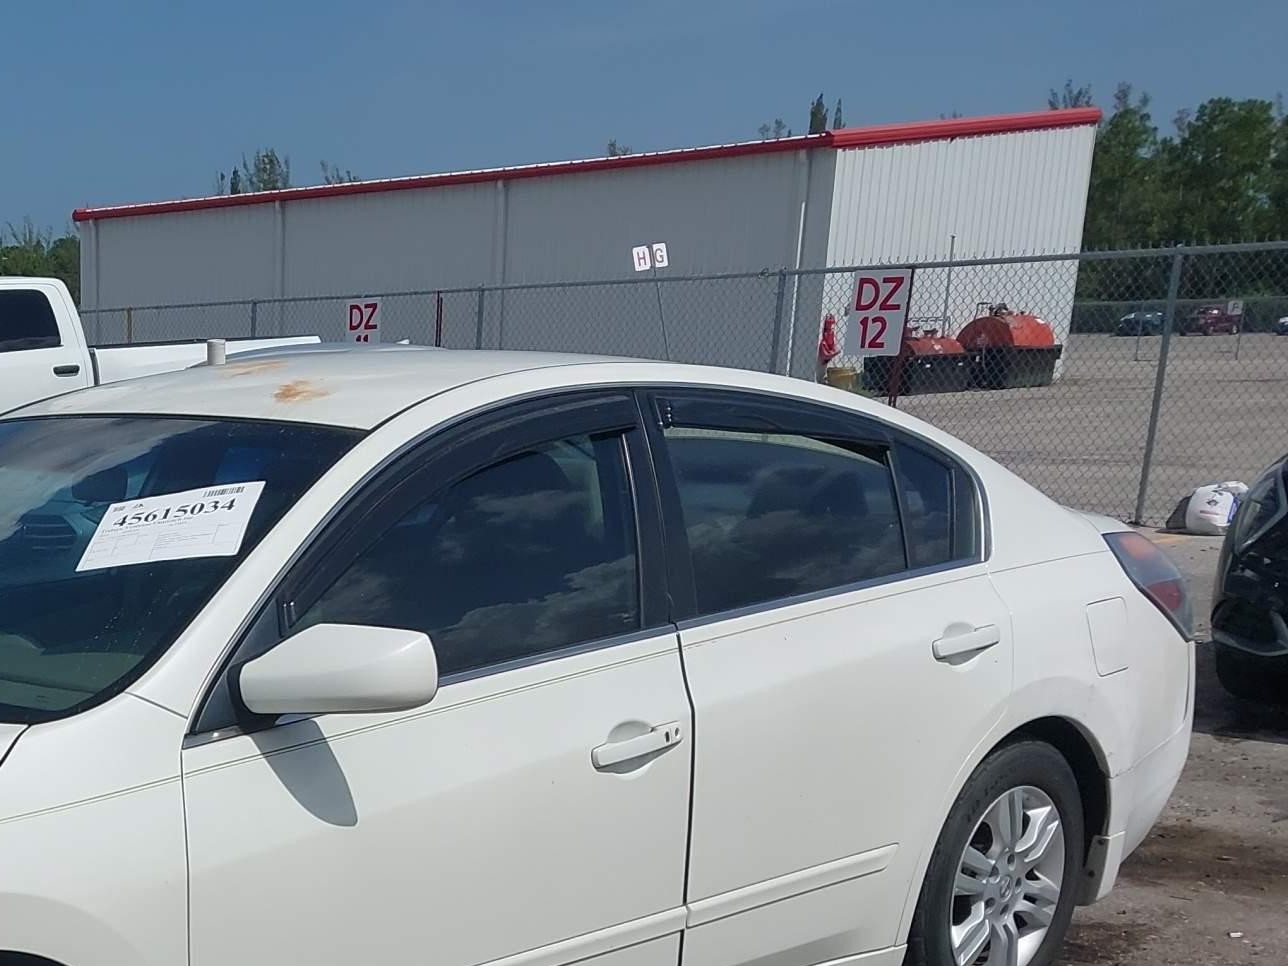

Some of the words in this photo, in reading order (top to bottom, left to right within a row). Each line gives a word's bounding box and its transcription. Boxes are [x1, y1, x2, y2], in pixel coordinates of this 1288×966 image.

[636, 250, 647, 267] H
[655, 248, 665, 264] G
[855, 276, 905, 312] DZ
[348, 303, 378, 331] DZ
[859, 316, 888, 349] 12
[112, 498, 236, 528] 45615034
